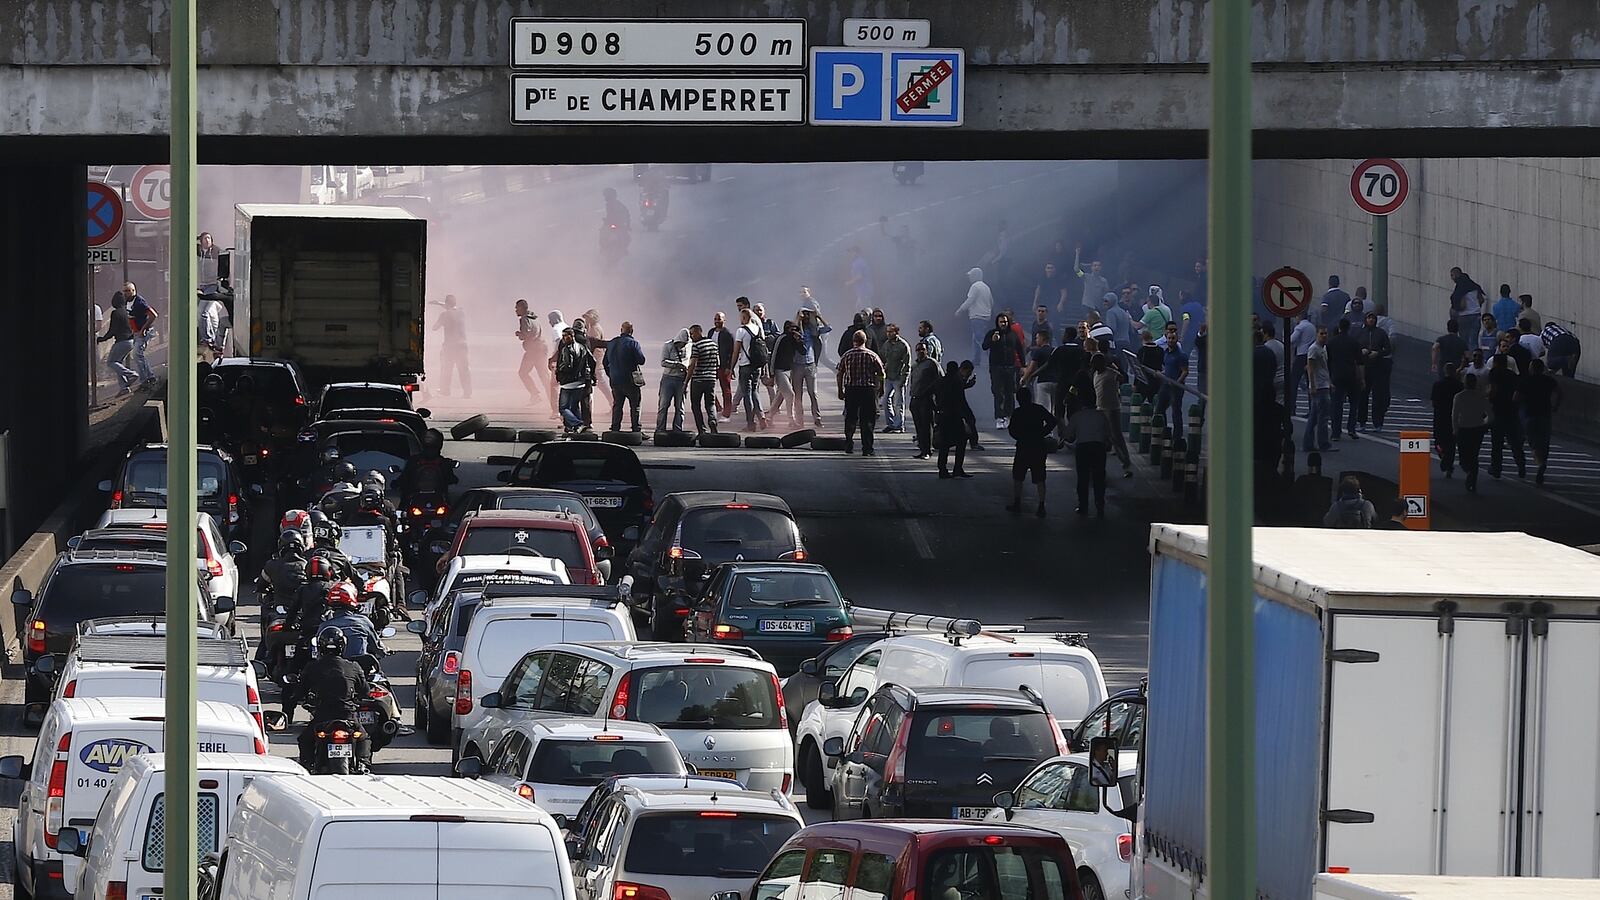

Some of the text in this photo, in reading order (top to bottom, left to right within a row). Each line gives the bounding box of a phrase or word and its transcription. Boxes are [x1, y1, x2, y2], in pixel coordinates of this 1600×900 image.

[531, 32, 620, 55] D 908
[695, 32, 792, 56] 500 m
[857, 26, 917, 41] 500 m
[832, 63, 865, 109] P
[902, 66, 947, 107] FERMÉE
[525, 88, 791, 111] PTE DE CHAMPERRET
[143, 178, 171, 203] 70
[1364, 172, 1397, 198] 70
[265, 335, 277, 346] 90
[1408, 441, 1420, 449] 81
[766, 621, 805, 631] DS-464-KE
[197, 743, 228, 753] ERIEL
[77, 778, 90, 788] 01
[94, 778, 107, 788] 40
